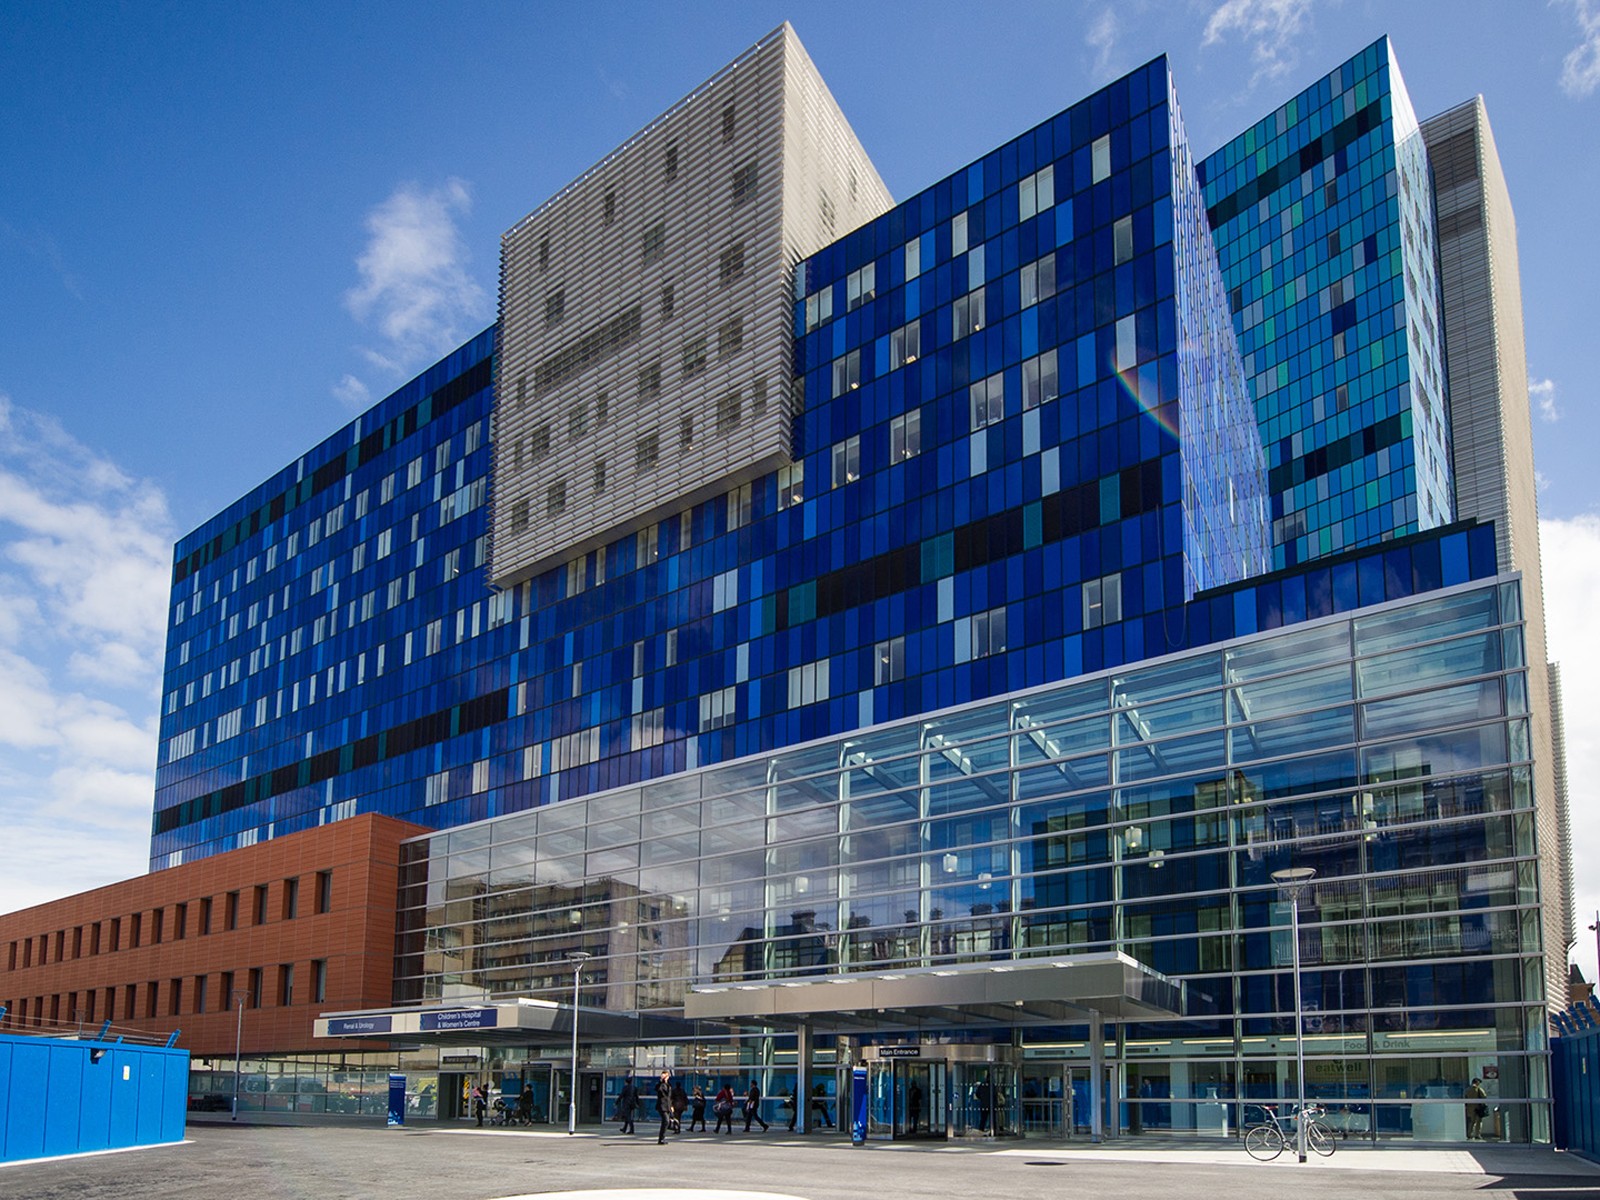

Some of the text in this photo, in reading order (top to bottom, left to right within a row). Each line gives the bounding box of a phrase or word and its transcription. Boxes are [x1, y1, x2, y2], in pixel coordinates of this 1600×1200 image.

[438, 1011, 481, 1020] Children's Hospital
[1383, 1040, 1410, 1048] Drink
[893, 1048, 918, 1056] Entrance
[1315, 1062, 1362, 1072] eatwell
